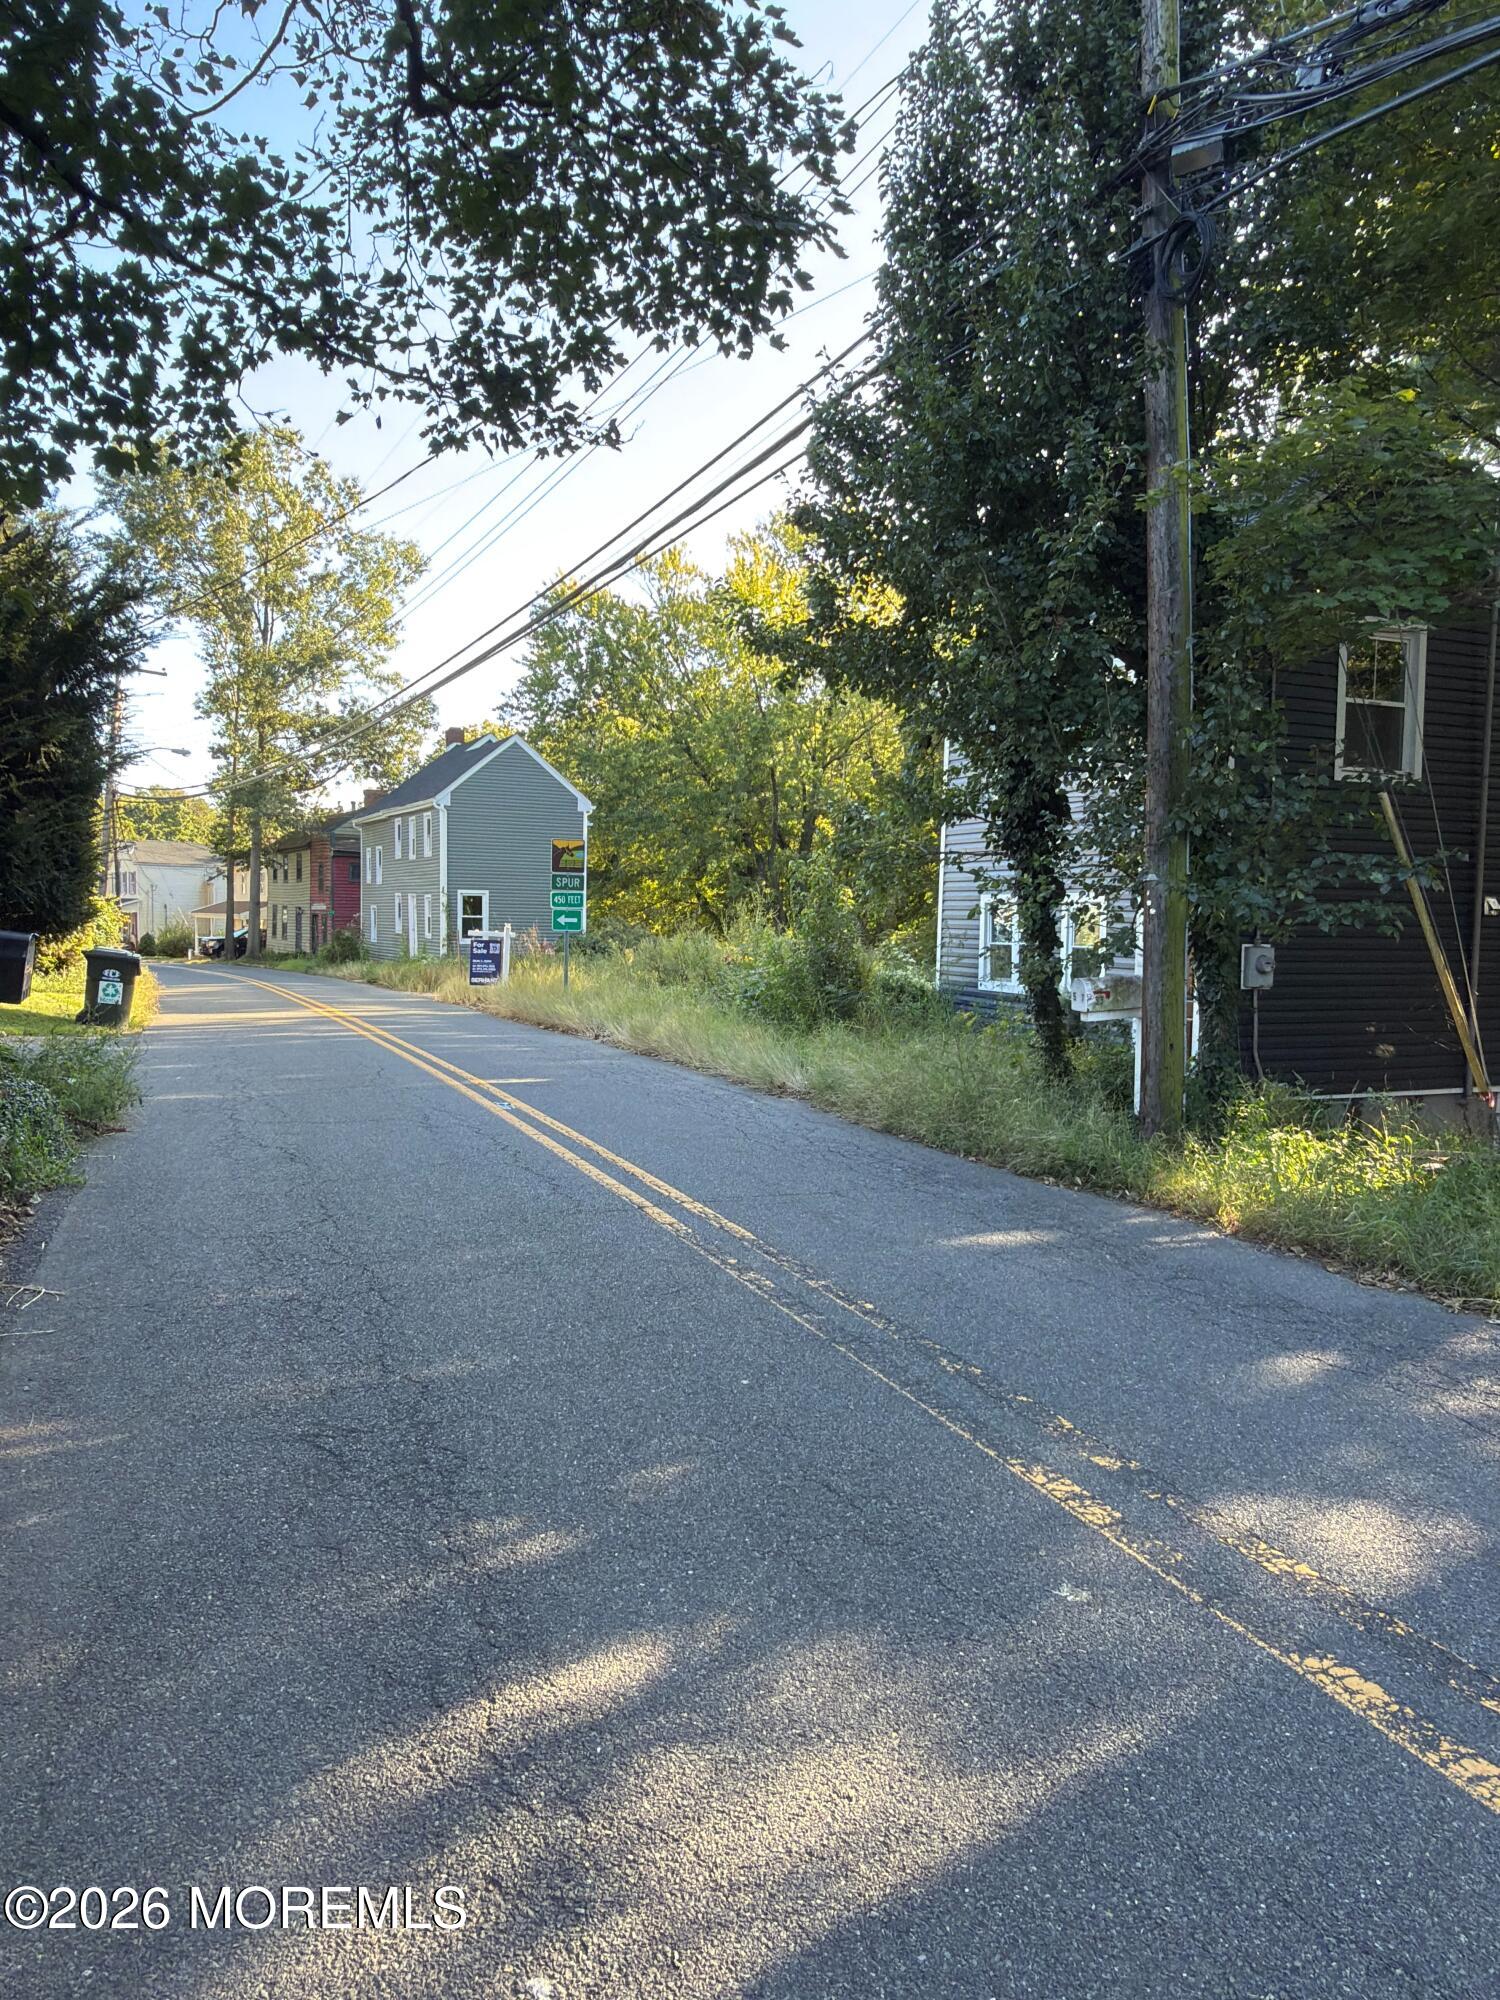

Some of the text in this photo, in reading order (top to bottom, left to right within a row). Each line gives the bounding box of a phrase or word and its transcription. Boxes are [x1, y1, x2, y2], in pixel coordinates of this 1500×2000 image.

[555, 877, 580, 888] SPUR
[553, 895, 581, 904] 450 FEET
